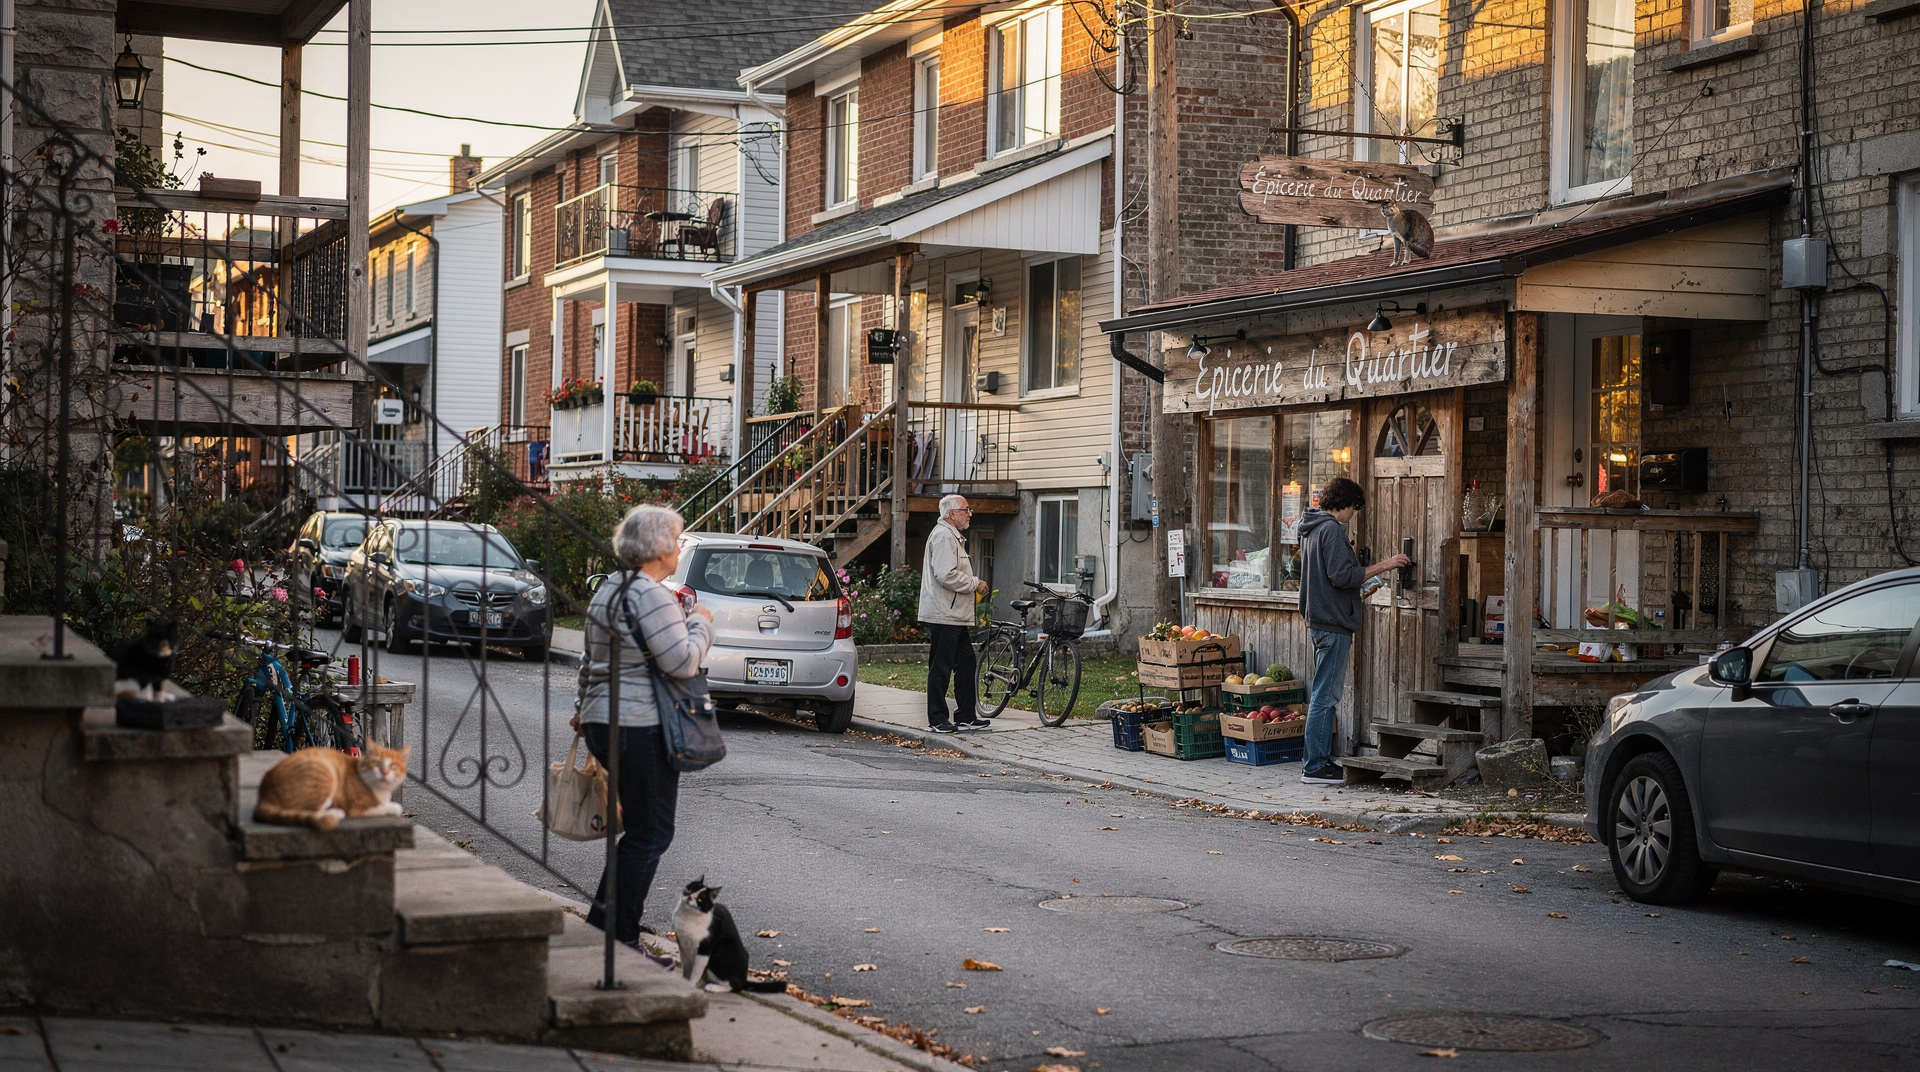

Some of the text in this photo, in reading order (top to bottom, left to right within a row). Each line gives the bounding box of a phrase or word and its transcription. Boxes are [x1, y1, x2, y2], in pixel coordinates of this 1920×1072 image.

[1324, 176, 1342, 199] du
[1351, 176, 1422, 204] Quartier
[1303, 349, 1327, 390] du
[1346, 322, 1458, 393] Quartier
